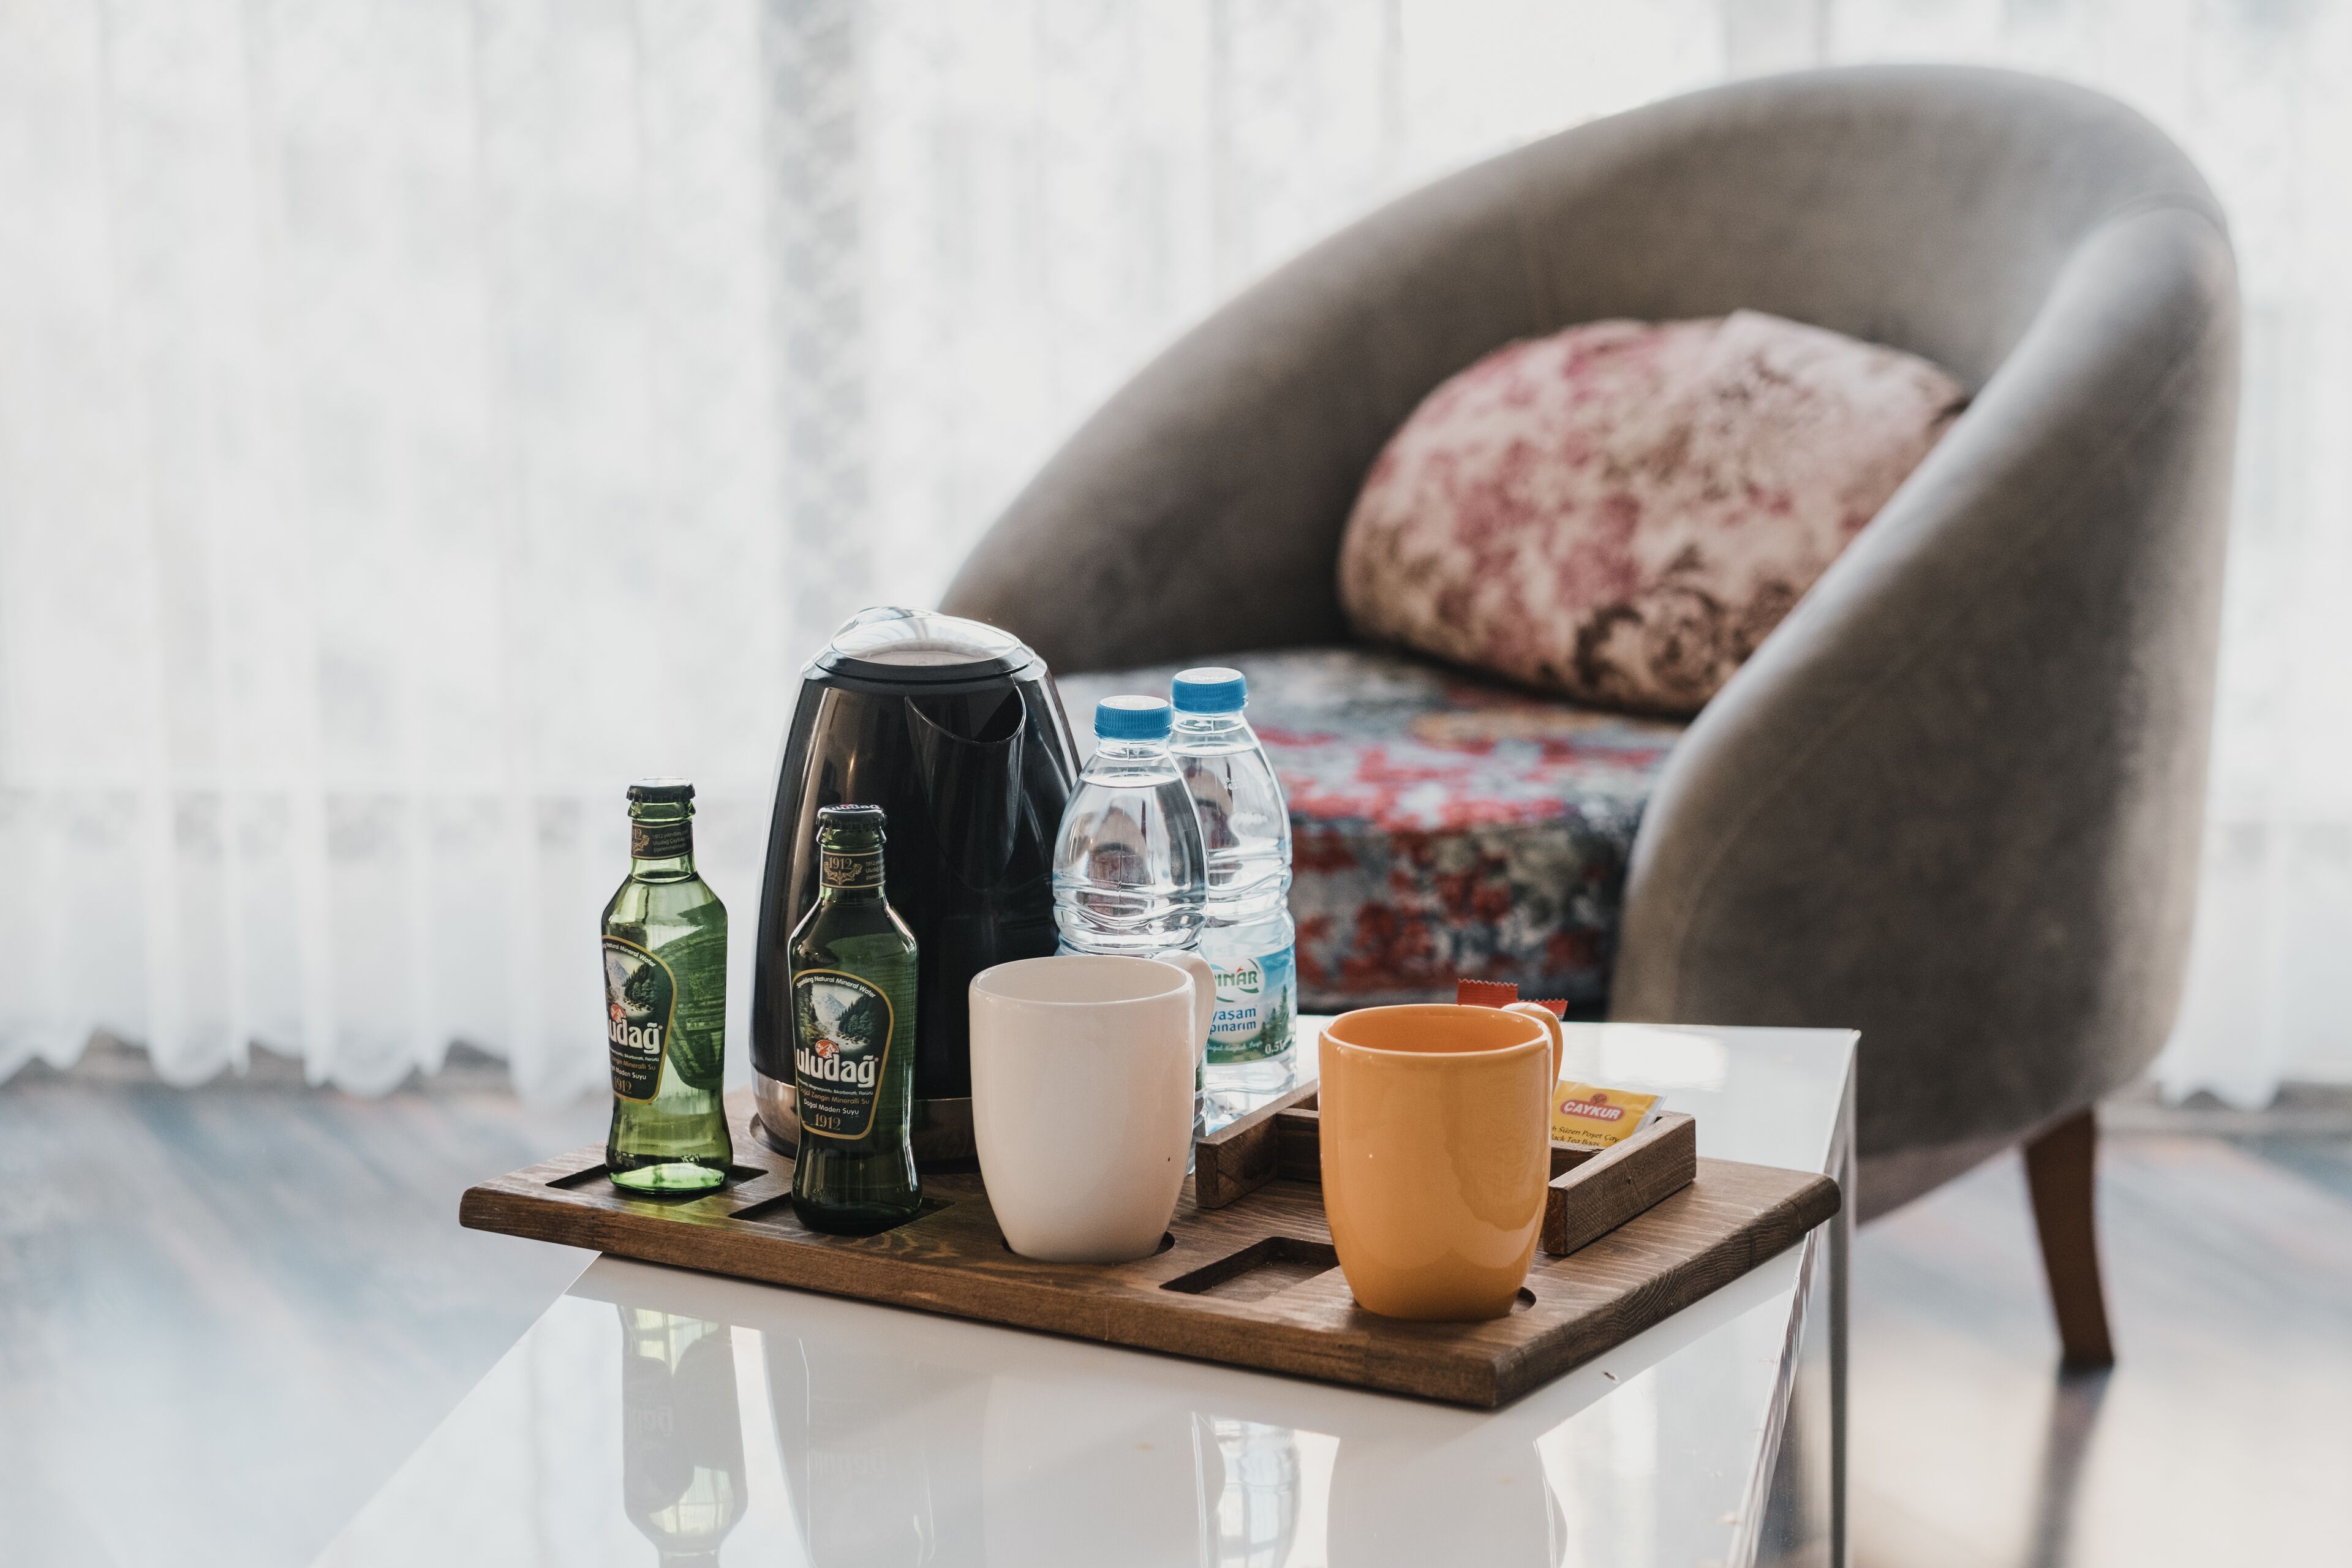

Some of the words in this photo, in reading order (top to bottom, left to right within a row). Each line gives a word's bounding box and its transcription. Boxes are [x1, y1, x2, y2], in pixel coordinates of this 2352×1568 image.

[829, 857, 853, 870] 1912
[619, 945, 639, 957] Mineral
[639, 954, 657, 968] Water
[796, 976, 814, 989] Sparkling
[835, 978, 858, 990] Mineral
[859, 985, 876, 998] Water
[1210, 1021, 1256, 1035] pınarım
[616, 1066, 631, 1077] Maden
[631, 1072, 647, 1080] Suyu
[624, 1060, 647, 1070] Mineralli
[796, 1047, 876, 1088] uludağ
[614, 1077, 632, 1095] 1912
[811, 1091, 831, 1102] Zengin
[804, 1098, 818, 1109] Doğal
[818, 1104, 841, 1113] Maden
[1563, 1101, 1622, 1120] ÇAYKUR
[815, 1113, 842, 1131] 1912
[1558, 1126, 1581, 1136] Süzen
[1581, 1130, 1603, 1139] Poşet
[1604, 1134, 1620, 1143] Çay
